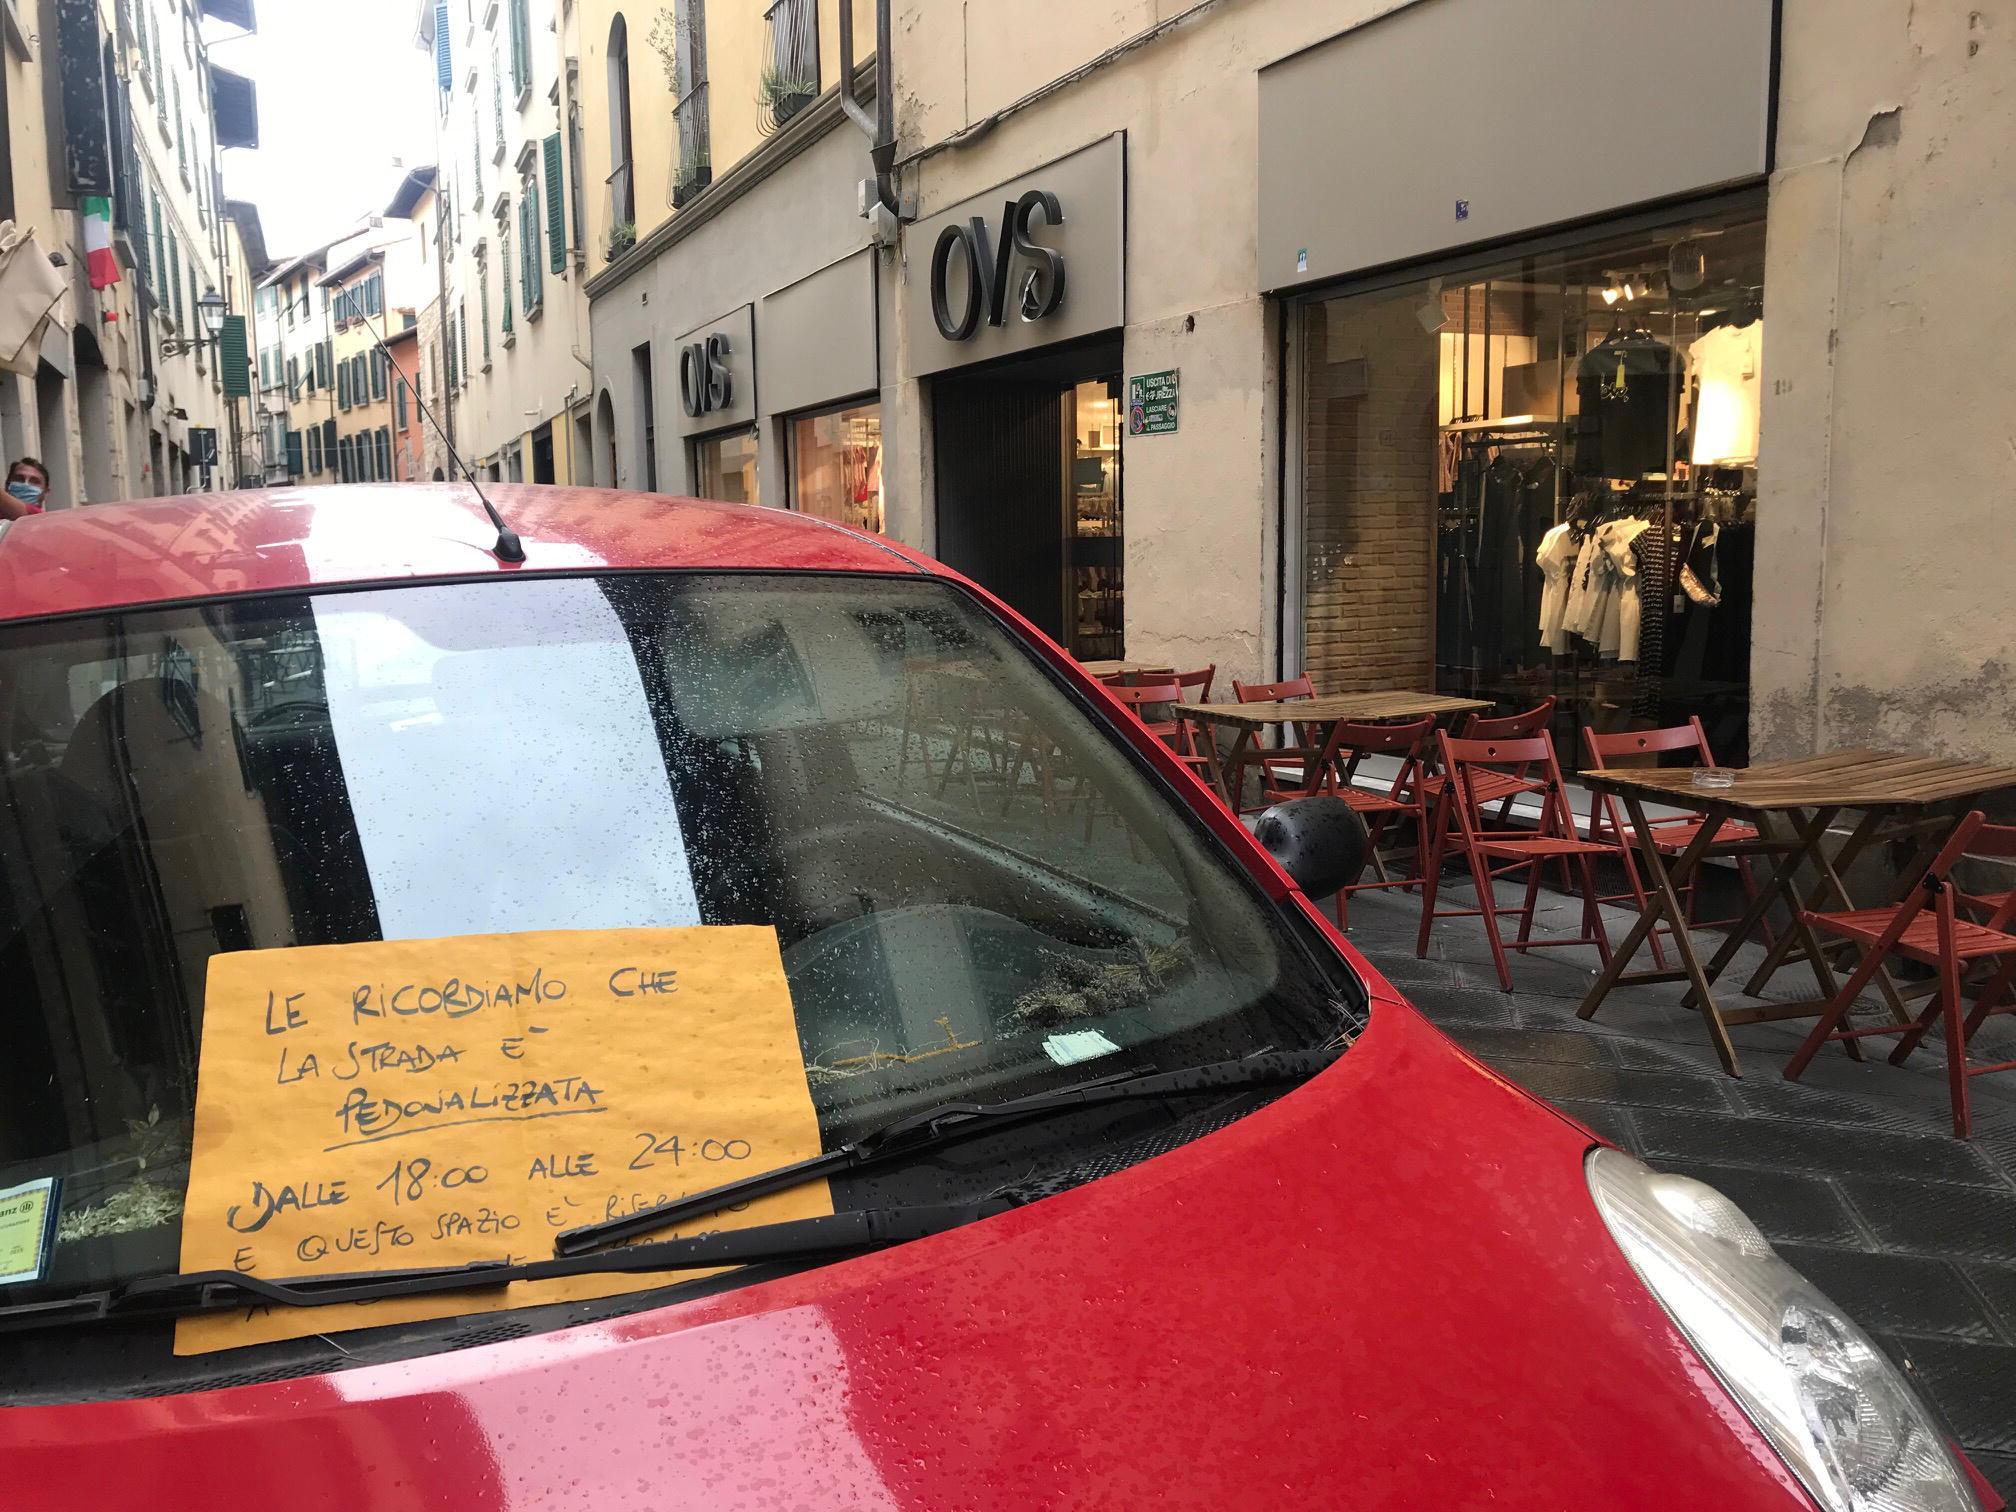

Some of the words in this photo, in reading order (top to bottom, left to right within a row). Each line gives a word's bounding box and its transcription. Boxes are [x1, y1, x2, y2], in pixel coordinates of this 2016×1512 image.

[930, 189, 1066, 342] OVS
[680, 332, 733, 418] OVS
[1146, 376, 1166, 388] USCITA
[265, 990, 309, 1035] LE
[608, 966, 678, 998] CHE
[277, 1046, 320, 1084] LA
[331, 1040, 468, 1081] STRADA
[227, 1180, 349, 1234] DALLE
[376, 1157, 489, 1206] 18:00
[528, 1153, 599, 1180] ALLE
[628, 1132, 752, 1171] 24:00
[232, 1246, 257, 1273] E
[296, 1221, 415, 1262] QUESTO
[430, 1207, 521, 1241] SPAZIO
